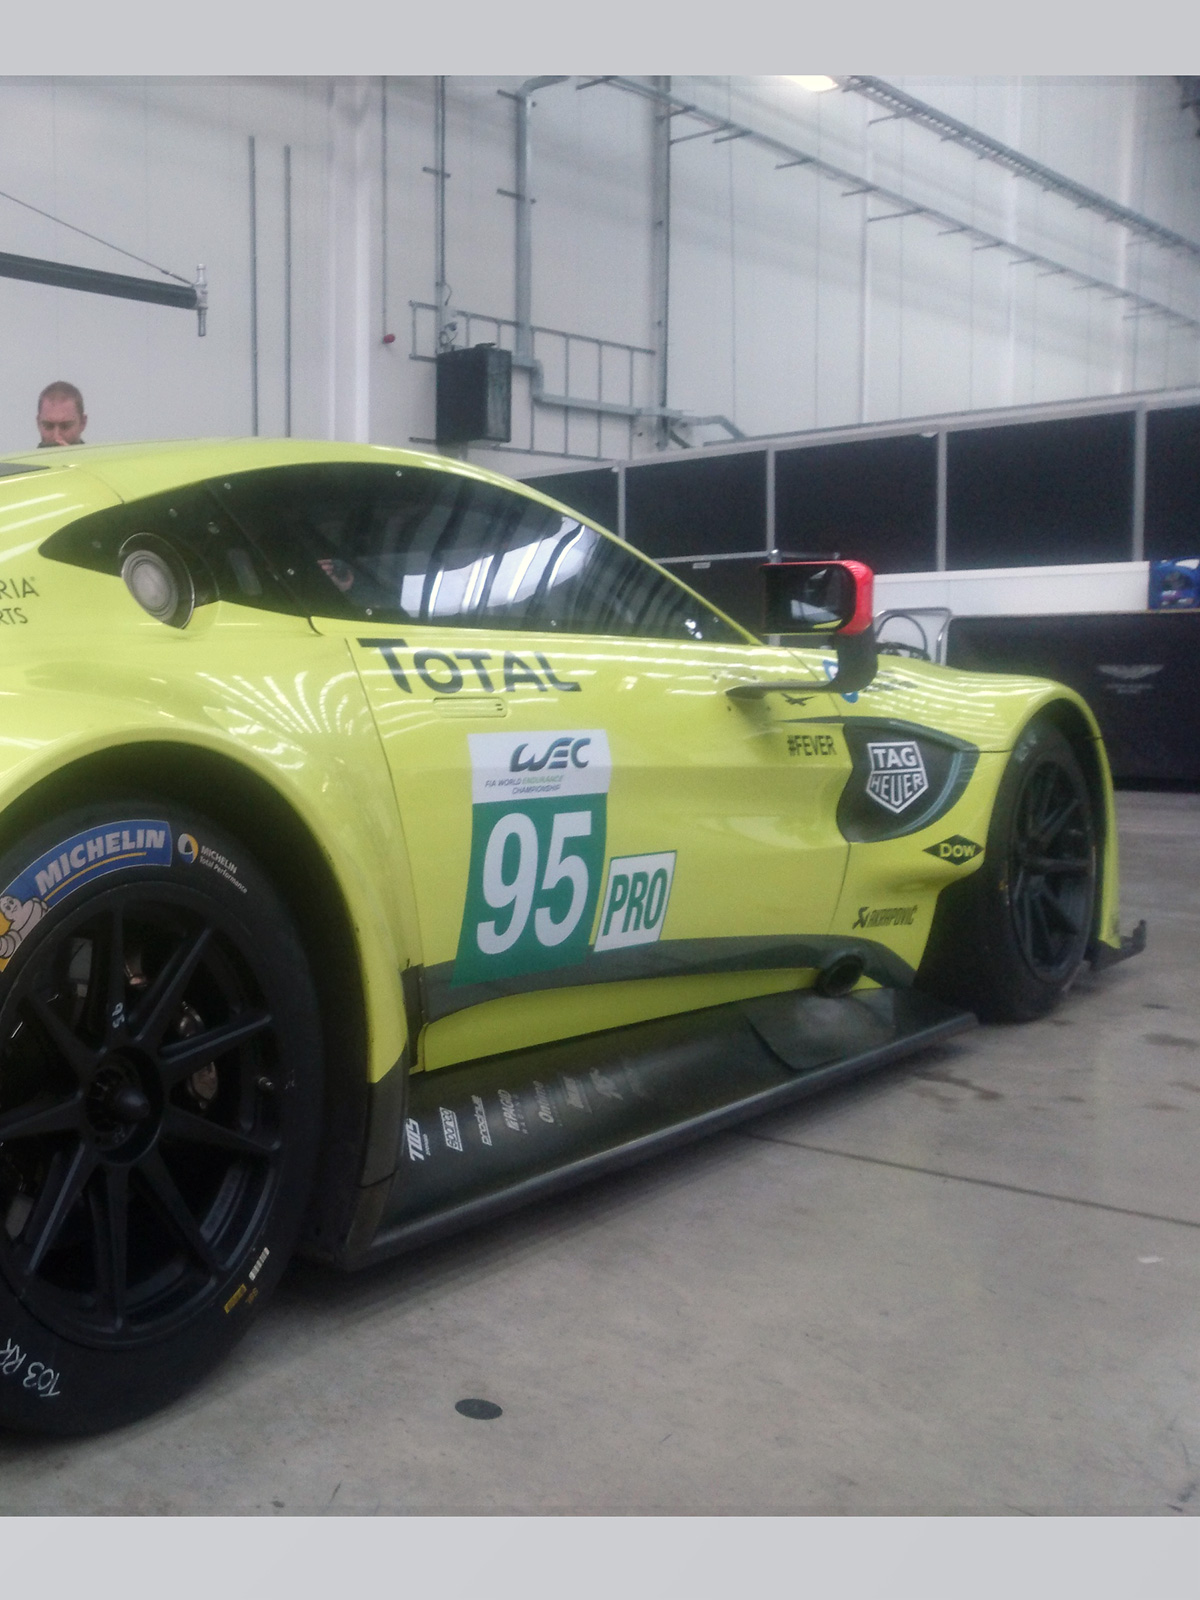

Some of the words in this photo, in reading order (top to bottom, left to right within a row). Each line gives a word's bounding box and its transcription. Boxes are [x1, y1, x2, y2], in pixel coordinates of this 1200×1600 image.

[357, 637, 582, 694] TOTAL
[508, 736, 592, 773] WEC
[787, 734, 838, 756] #FEVER
[872, 746, 918, 769] TAG
[497, 777, 521, 787] WORLD
[870, 773, 924, 807] HEUER
[33, 828, 167, 897] MICHELIN
[201, 845, 238, 875] MICHELIN
[476, 810, 593, 956] 95
[602, 867, 668, 937] PRO
